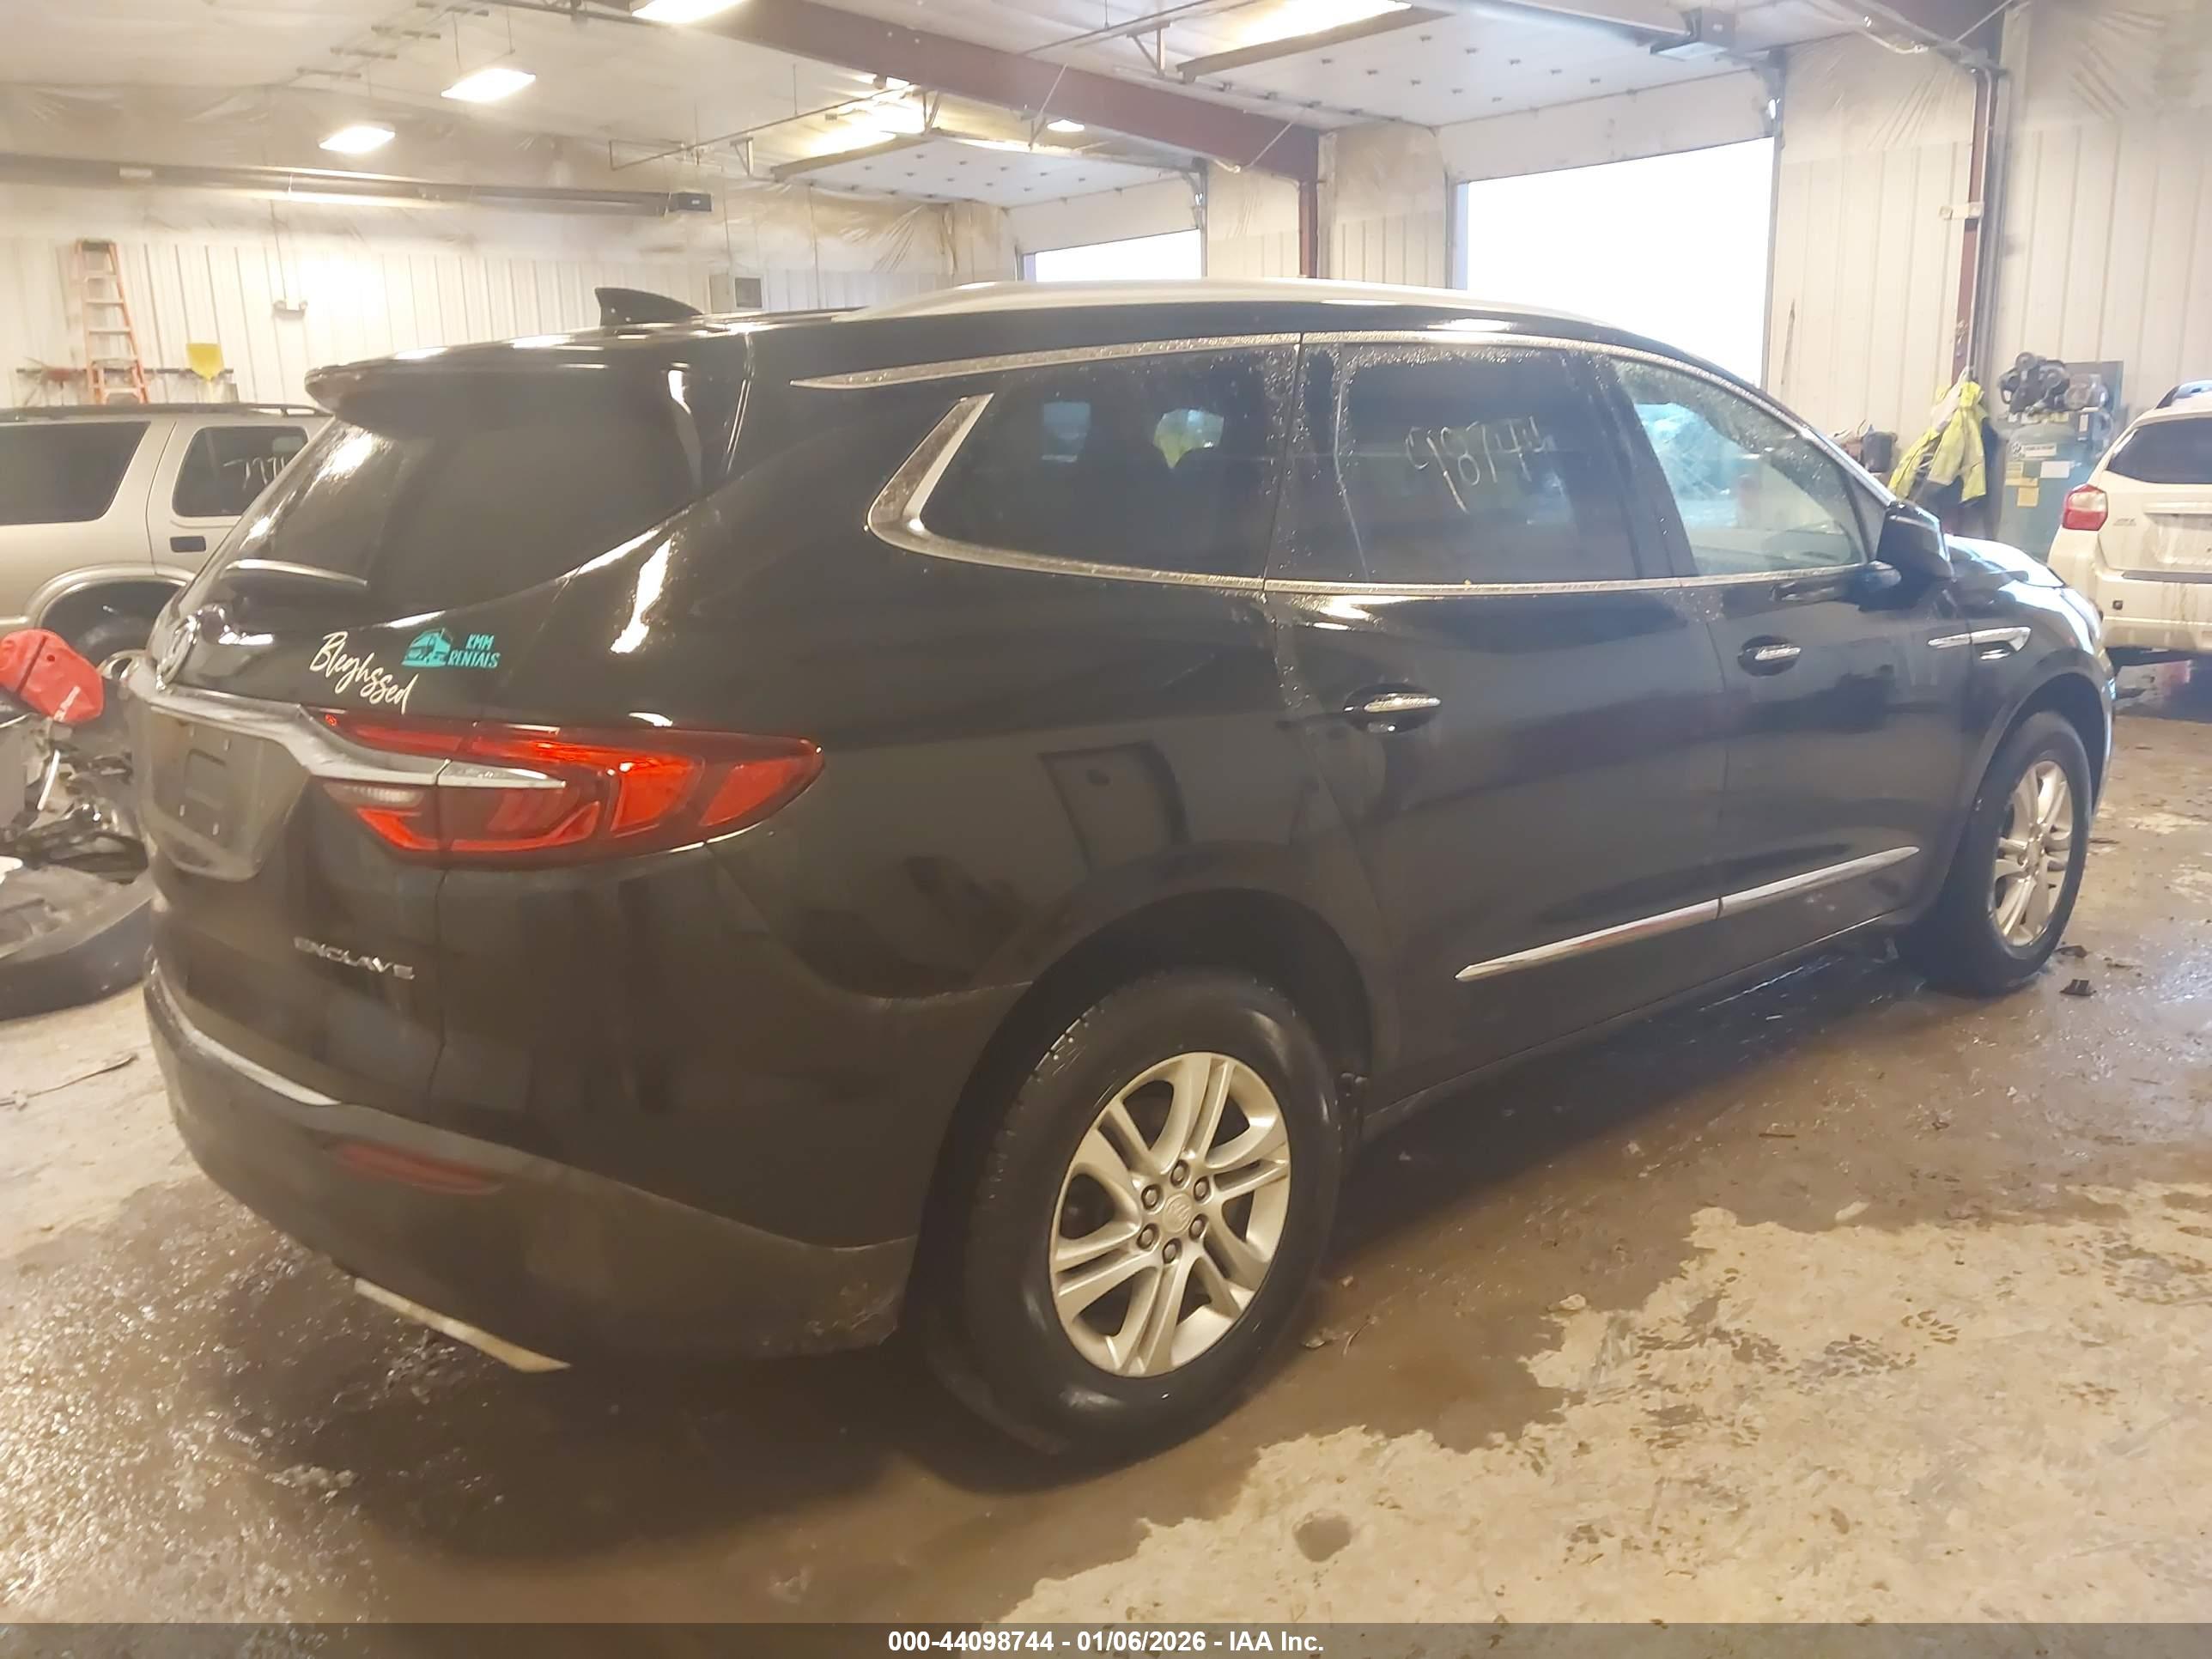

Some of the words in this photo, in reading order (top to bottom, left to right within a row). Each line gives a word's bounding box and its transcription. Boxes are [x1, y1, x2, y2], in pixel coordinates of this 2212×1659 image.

[465, 633, 495, 651] KMM
[447, 650, 501, 669] RENTALS
[292, 935, 416, 981] ENCLAVE
